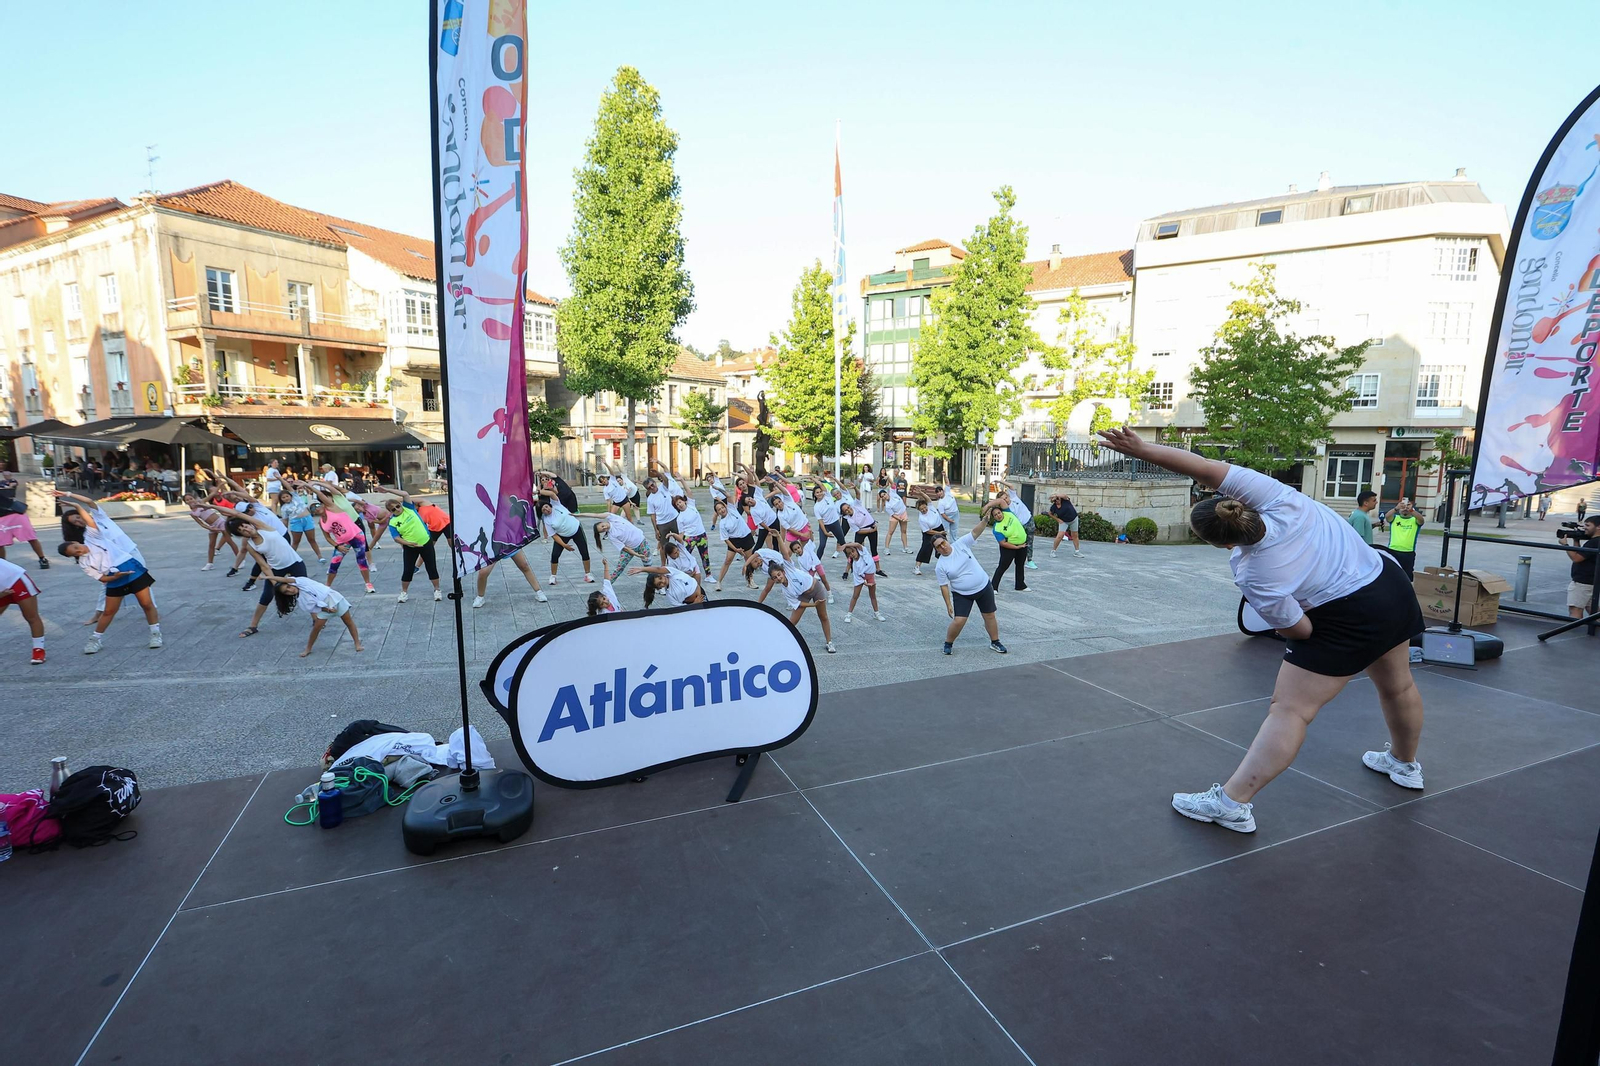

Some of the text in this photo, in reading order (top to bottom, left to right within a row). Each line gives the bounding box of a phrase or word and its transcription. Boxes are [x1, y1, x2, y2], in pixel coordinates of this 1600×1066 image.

[458, 77, 470, 141] Concello
[1550, 250, 1563, 283] Concello
[537, 652, 802, 743] Atlántico
